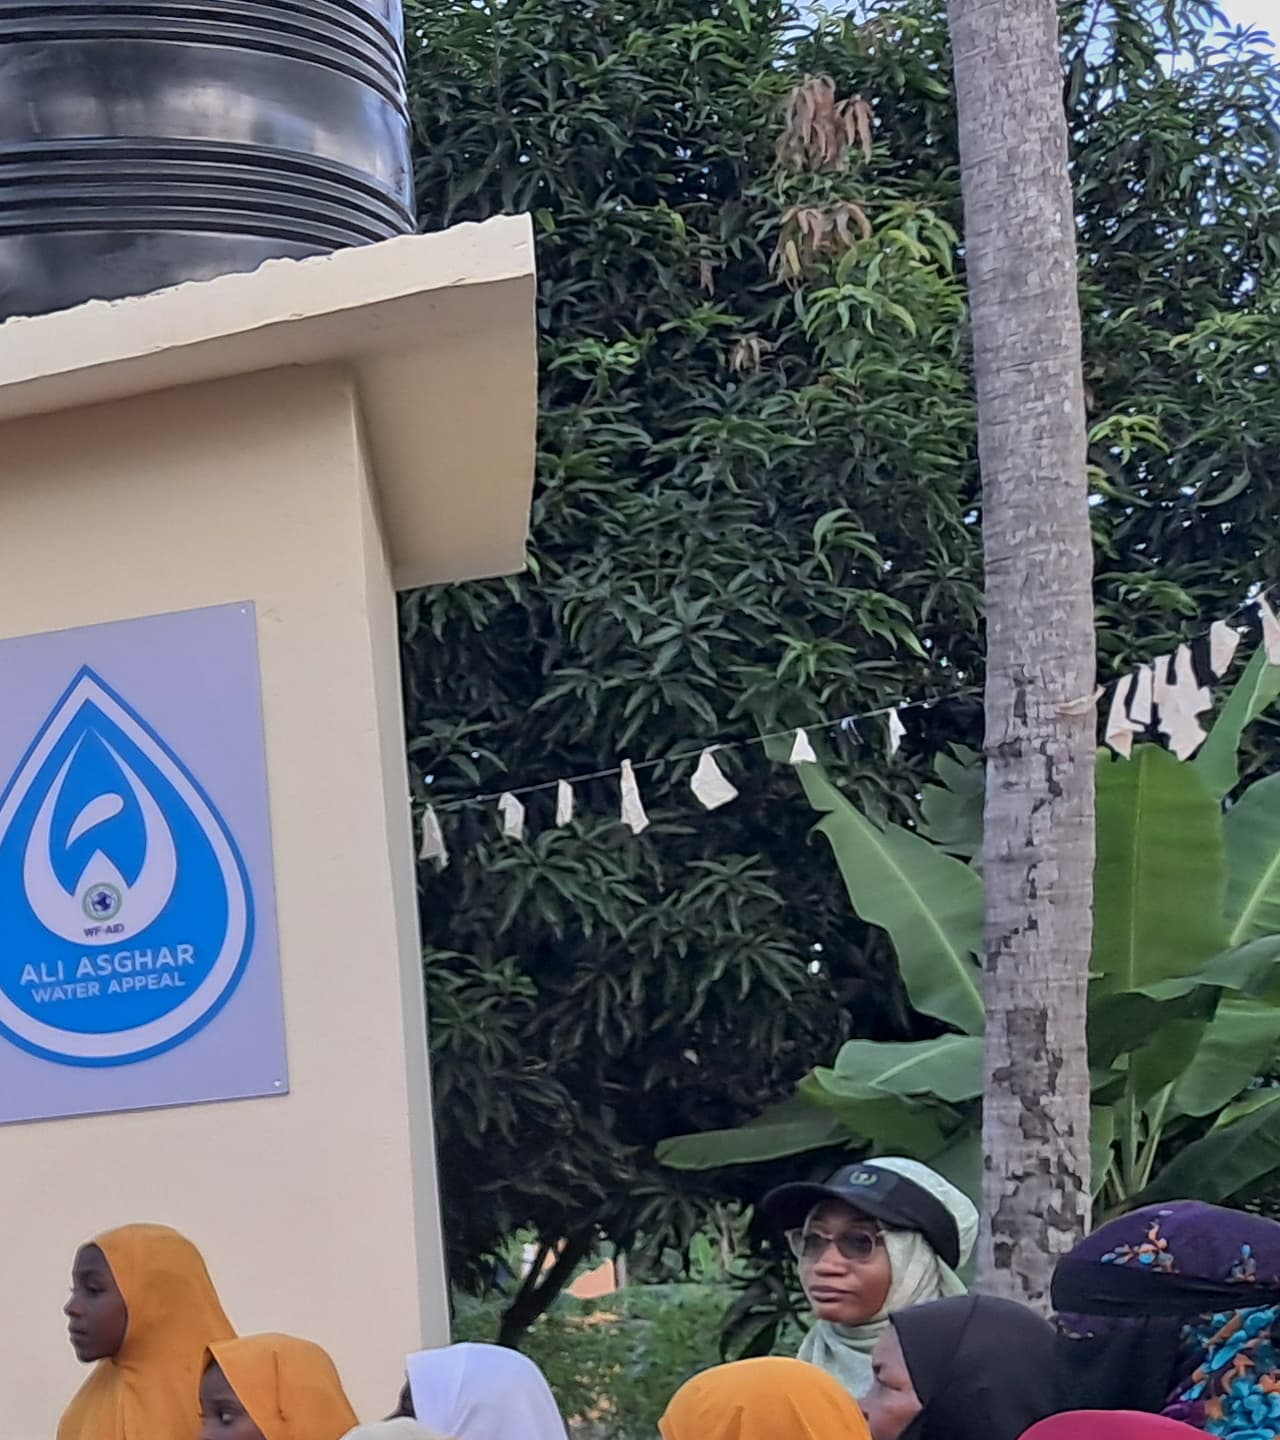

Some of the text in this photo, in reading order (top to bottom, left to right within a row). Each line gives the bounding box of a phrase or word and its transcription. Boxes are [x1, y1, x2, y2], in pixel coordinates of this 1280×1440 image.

[19, 944, 195, 986] ALI ASGHAR
[31, 971, 186, 1004] WATER APPEAL
